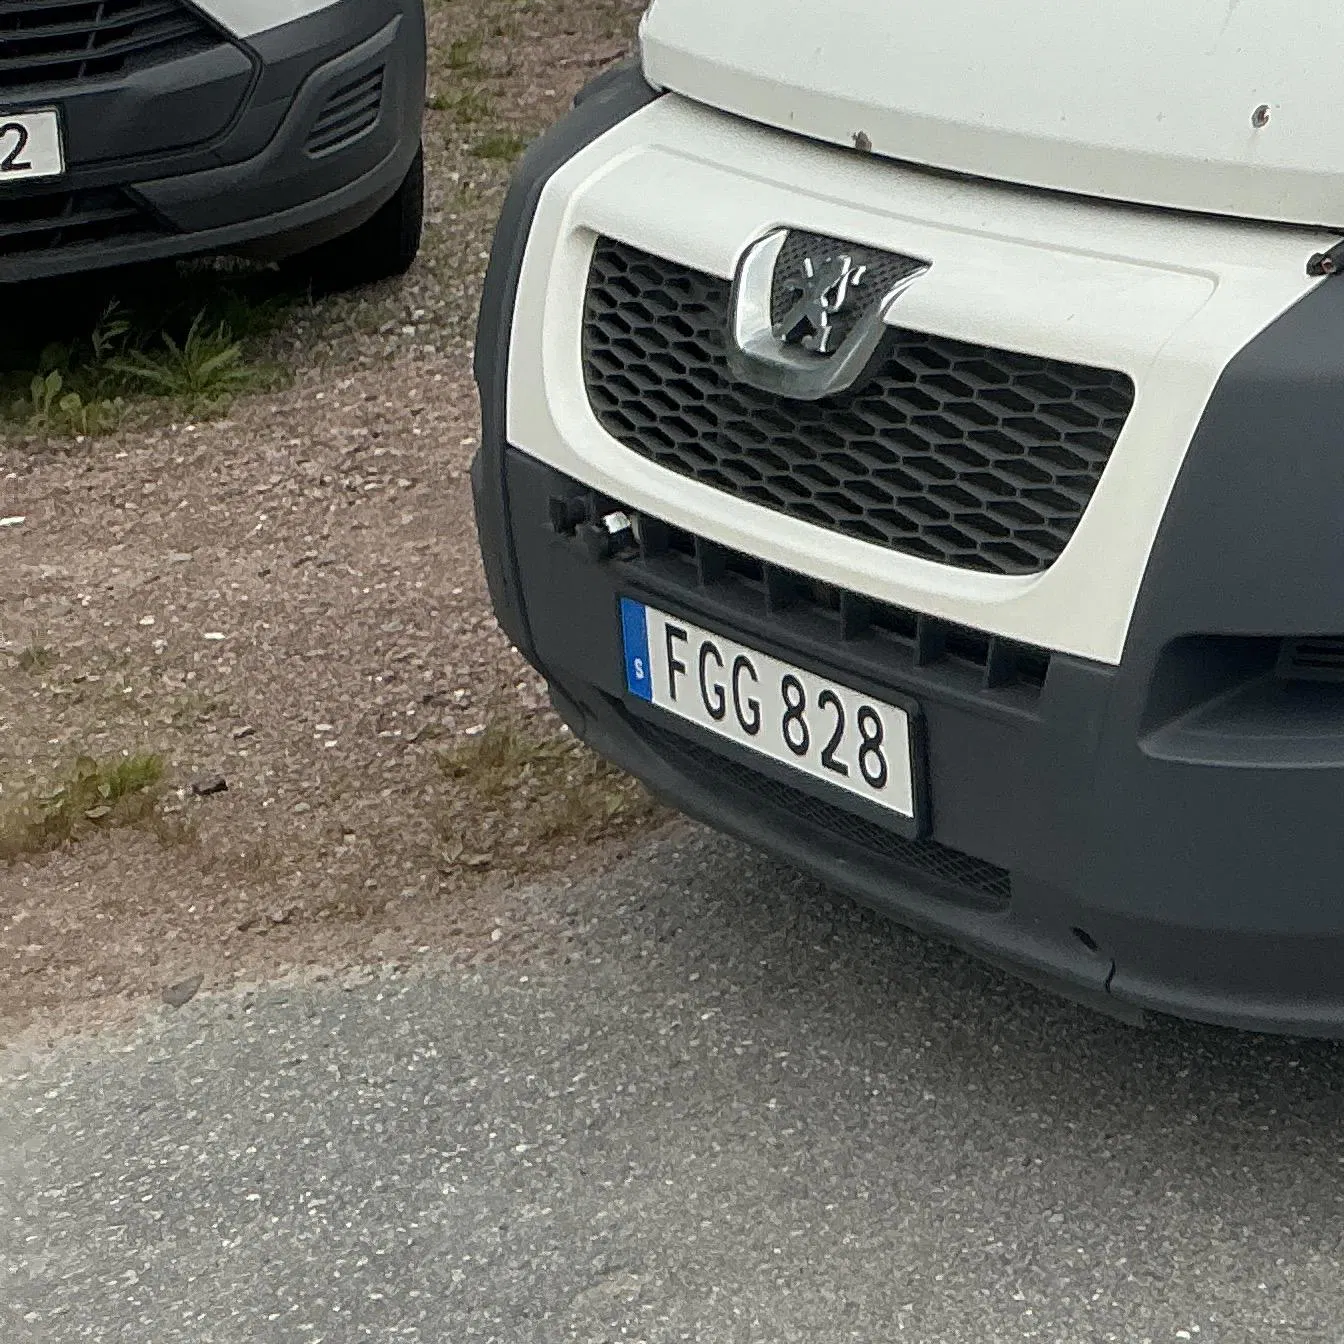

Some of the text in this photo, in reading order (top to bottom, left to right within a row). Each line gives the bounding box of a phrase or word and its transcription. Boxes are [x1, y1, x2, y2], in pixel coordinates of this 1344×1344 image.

[0, 122, 32, 171] 2
[633, 621, 889, 790] S FGG 828
